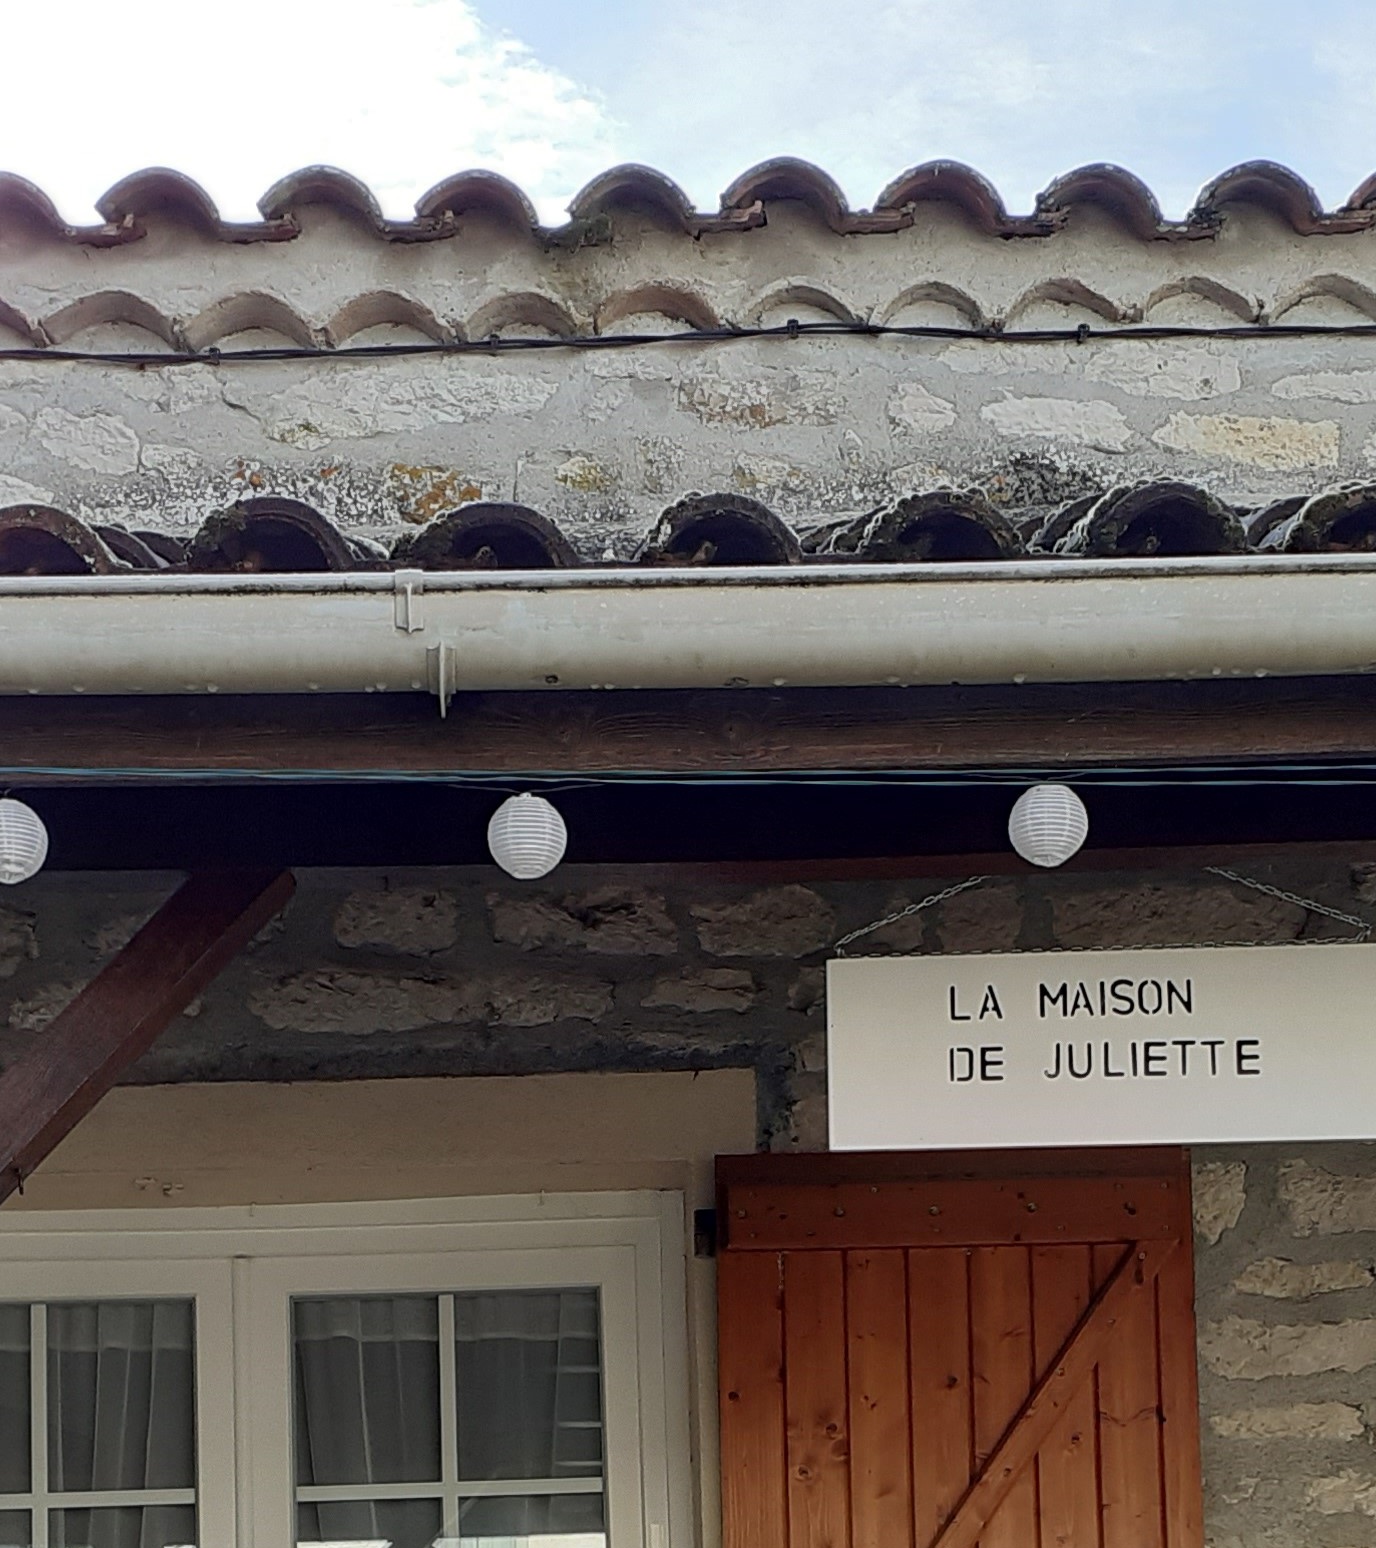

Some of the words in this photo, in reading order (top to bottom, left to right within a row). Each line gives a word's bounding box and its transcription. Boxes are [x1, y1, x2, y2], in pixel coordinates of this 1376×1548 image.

[949, 984, 1003, 1021] LA
[1039, 979, 1193, 1018] MAISON
[949, 1046, 1004, 1081] DE
[1044, 1040, 1261, 1078] JULIETTE
